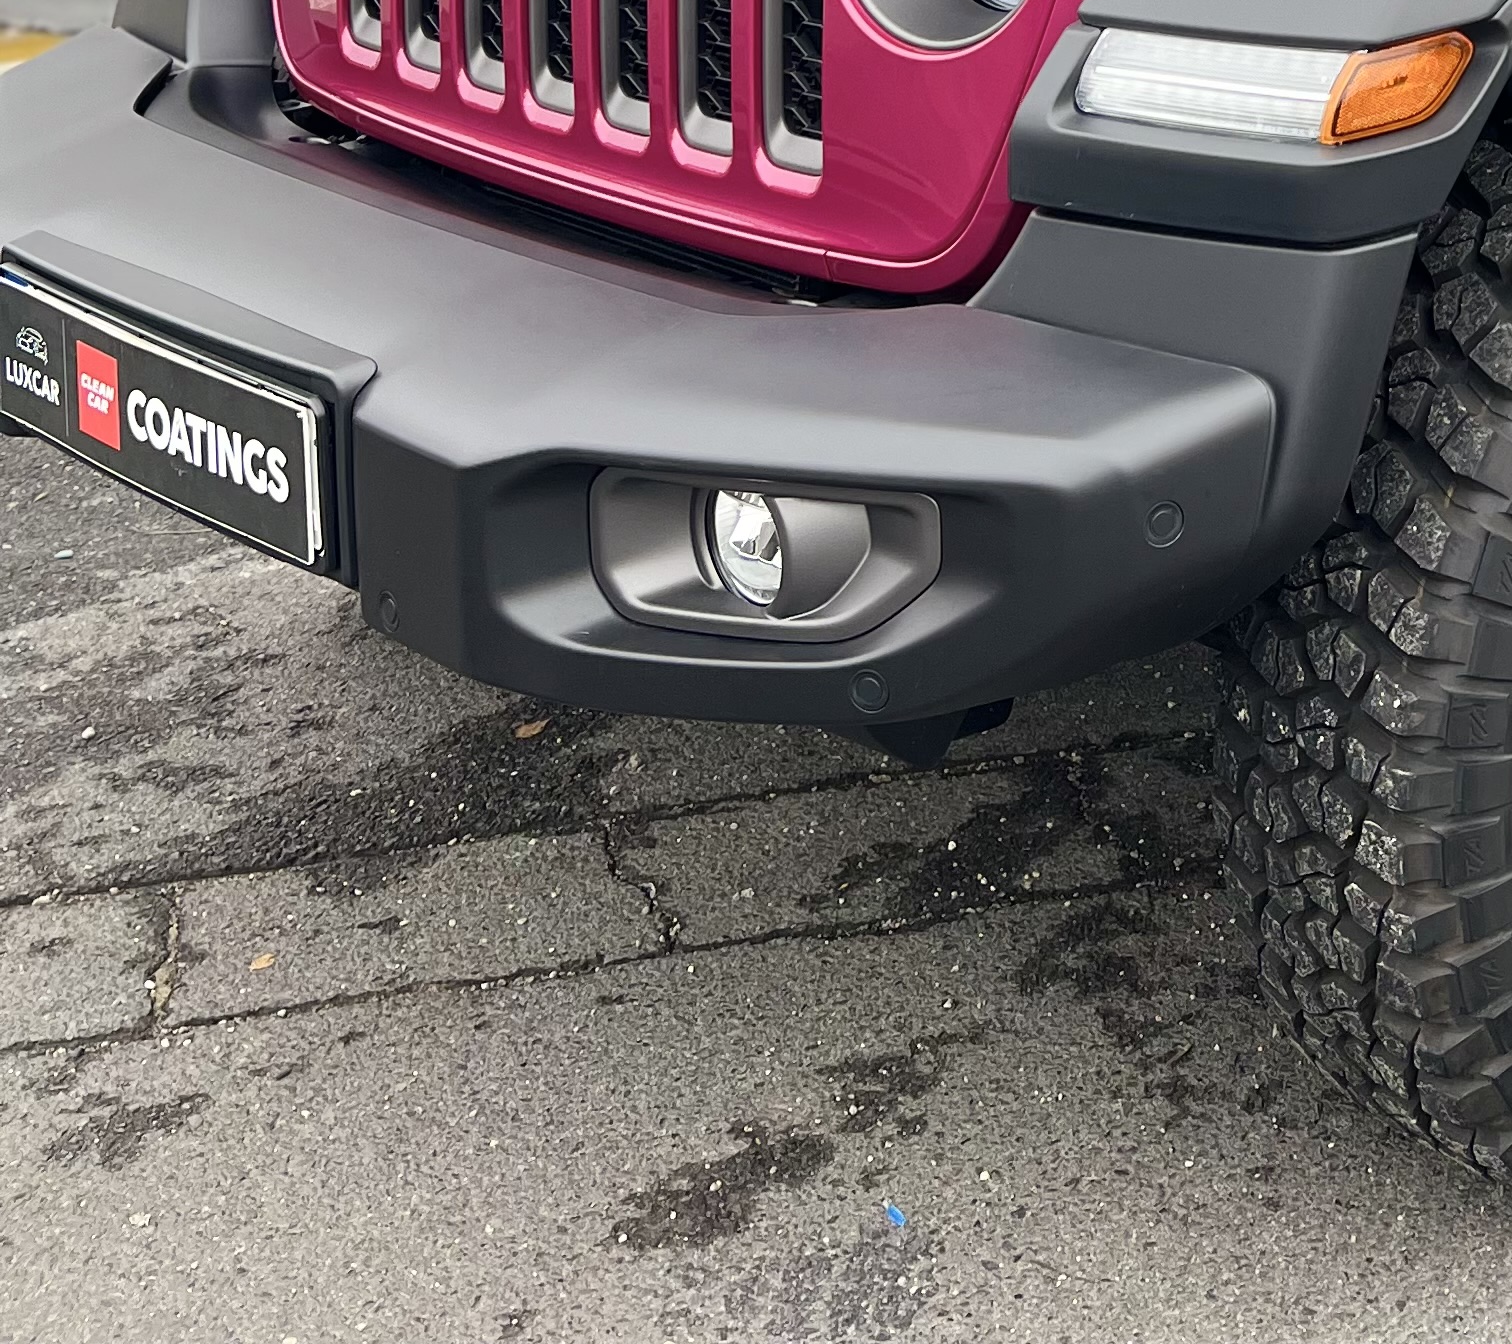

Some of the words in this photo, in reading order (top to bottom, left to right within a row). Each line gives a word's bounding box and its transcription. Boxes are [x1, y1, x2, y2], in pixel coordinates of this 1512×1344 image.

[5, 356, 60, 406] LUXCAR
[80, 372, 115, 402] CLEAN
[87, 391, 109, 415] CAR
[126, 388, 290, 503] COATINGS
